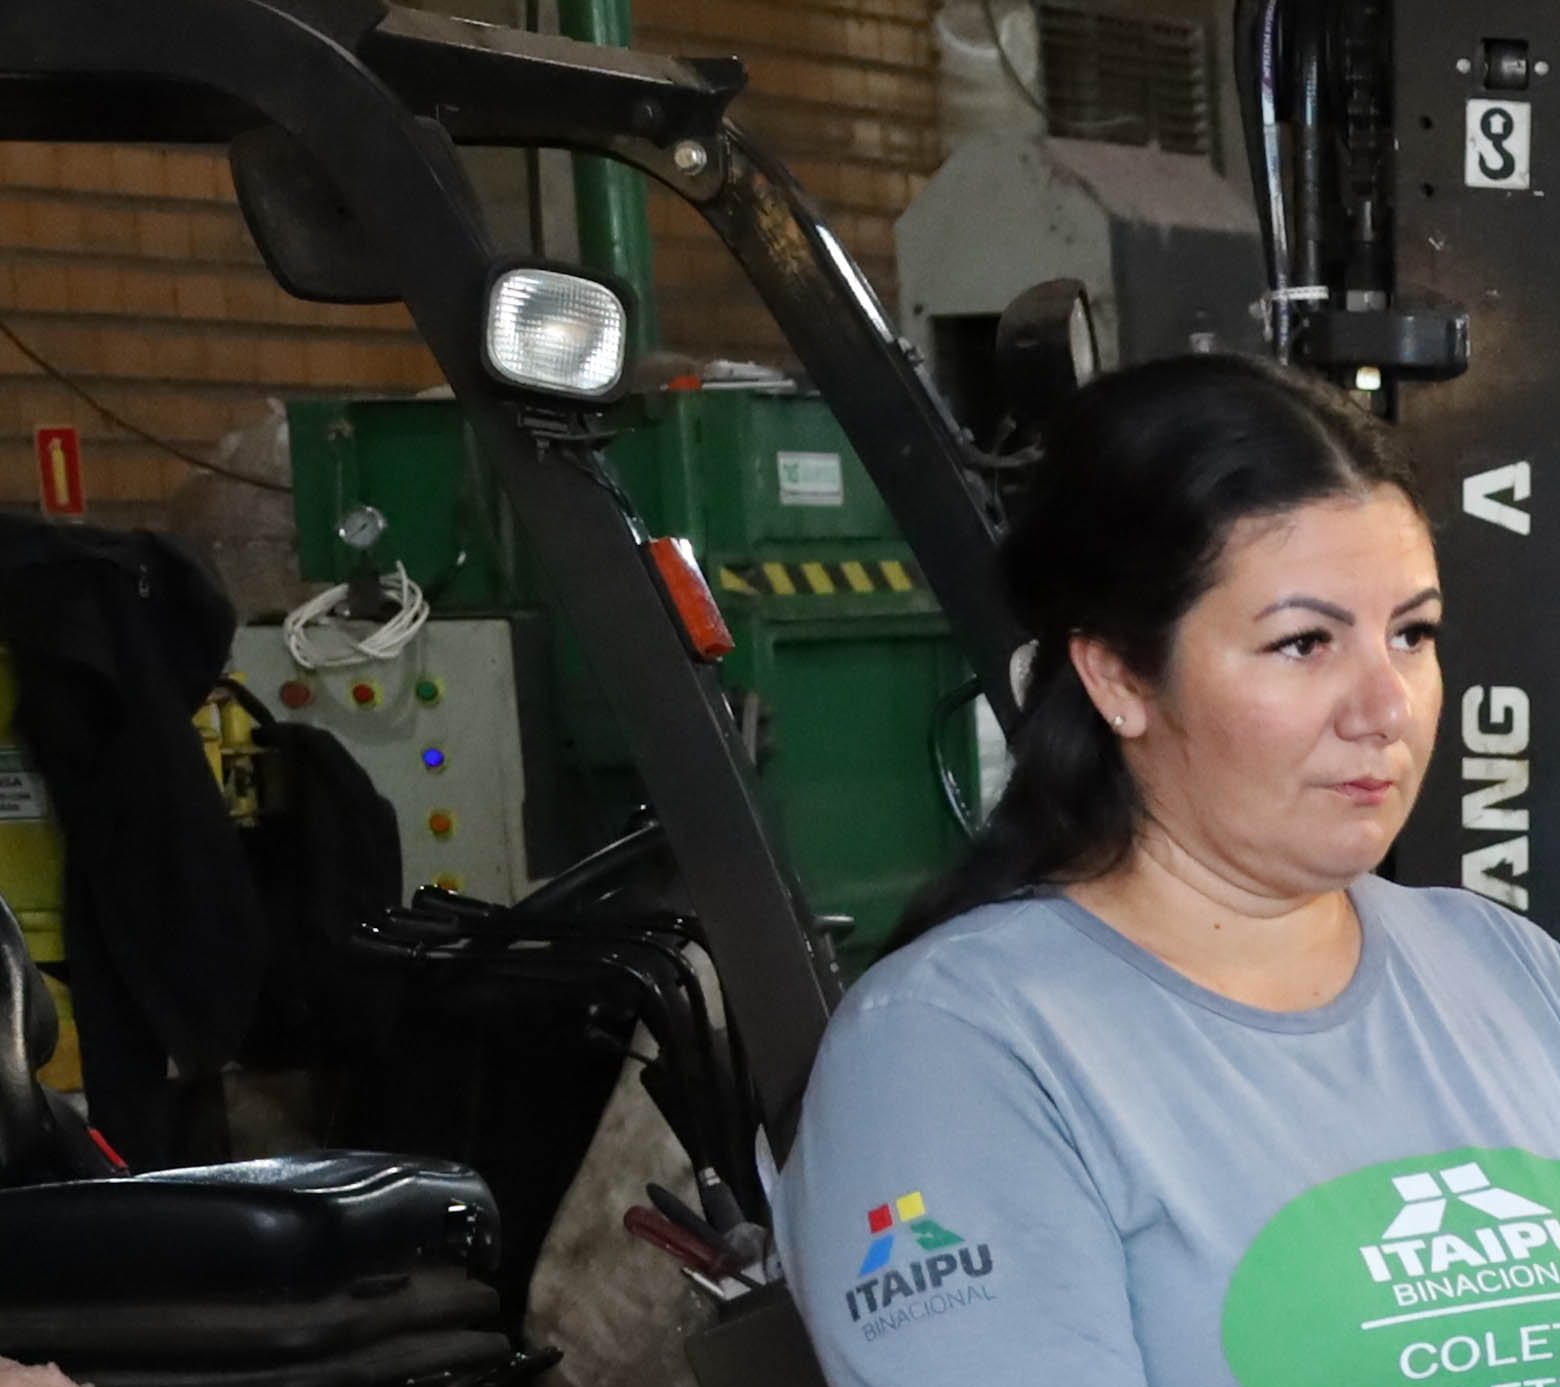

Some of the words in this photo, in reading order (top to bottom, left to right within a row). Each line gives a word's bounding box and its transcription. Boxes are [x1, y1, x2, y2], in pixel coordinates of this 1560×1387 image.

[1461, 685, 1530, 911] ANG
[846, 1243, 994, 1323] ITAIPU
[861, 1285, 998, 1343] BINACIONAL
